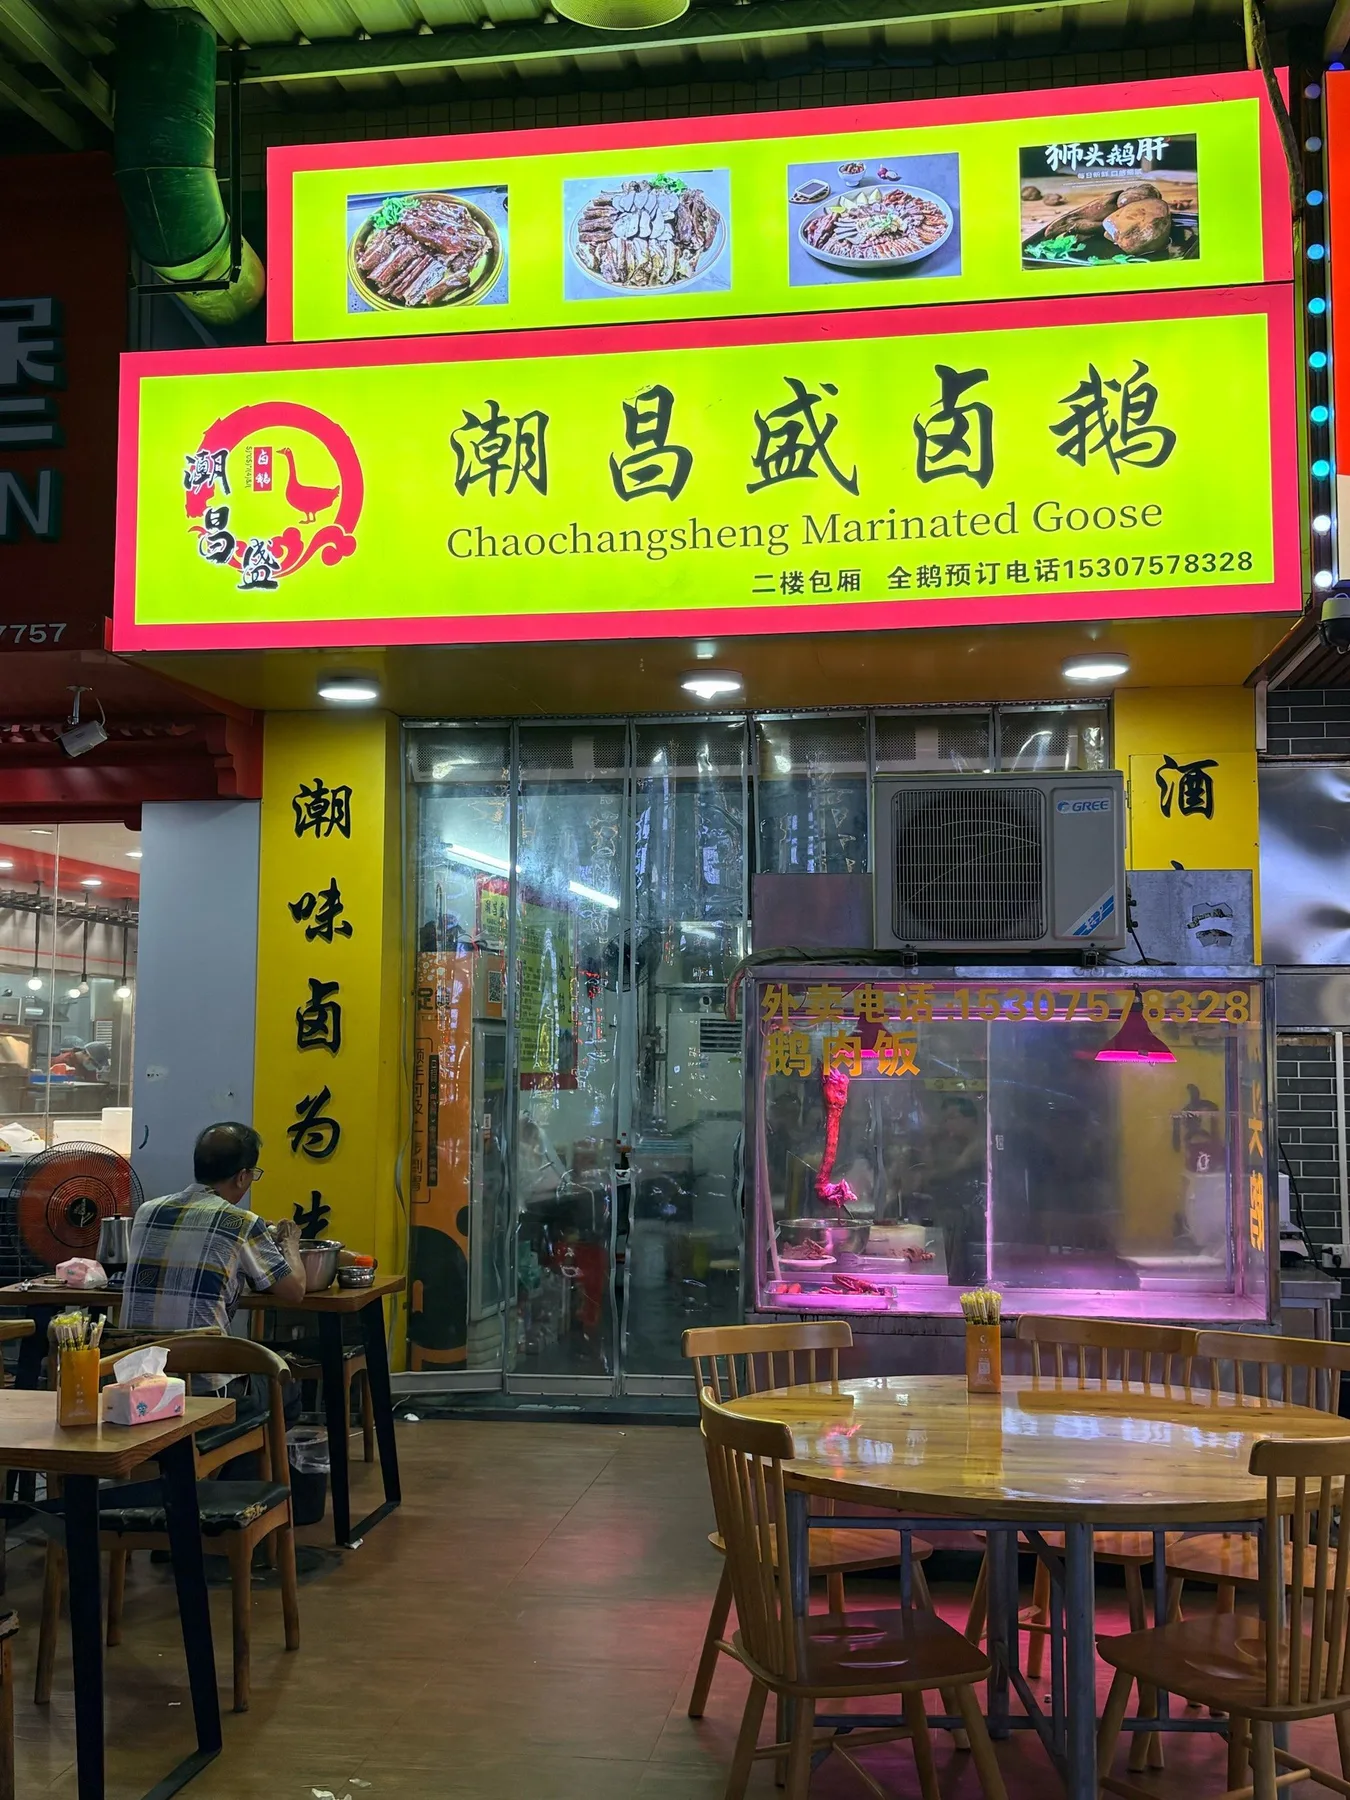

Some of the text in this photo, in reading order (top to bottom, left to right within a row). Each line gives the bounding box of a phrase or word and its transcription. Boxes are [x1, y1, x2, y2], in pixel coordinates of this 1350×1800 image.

[1044, 137, 1169, 171] 狮头鹅肝
[450, 358, 1177, 502] 潮昌盛卤鹅
[184, 449, 281, 590] 潮昌盛
[447, 500, 1163, 561] Chaochangsheng Marinated Goose
[751, 551, 1254, 595] 二楼包厢 全鹅预订电话15307578328
[1072, 800, 1109, 812] GREE
[764, 1028, 921, 1077] 鹅肉饭
